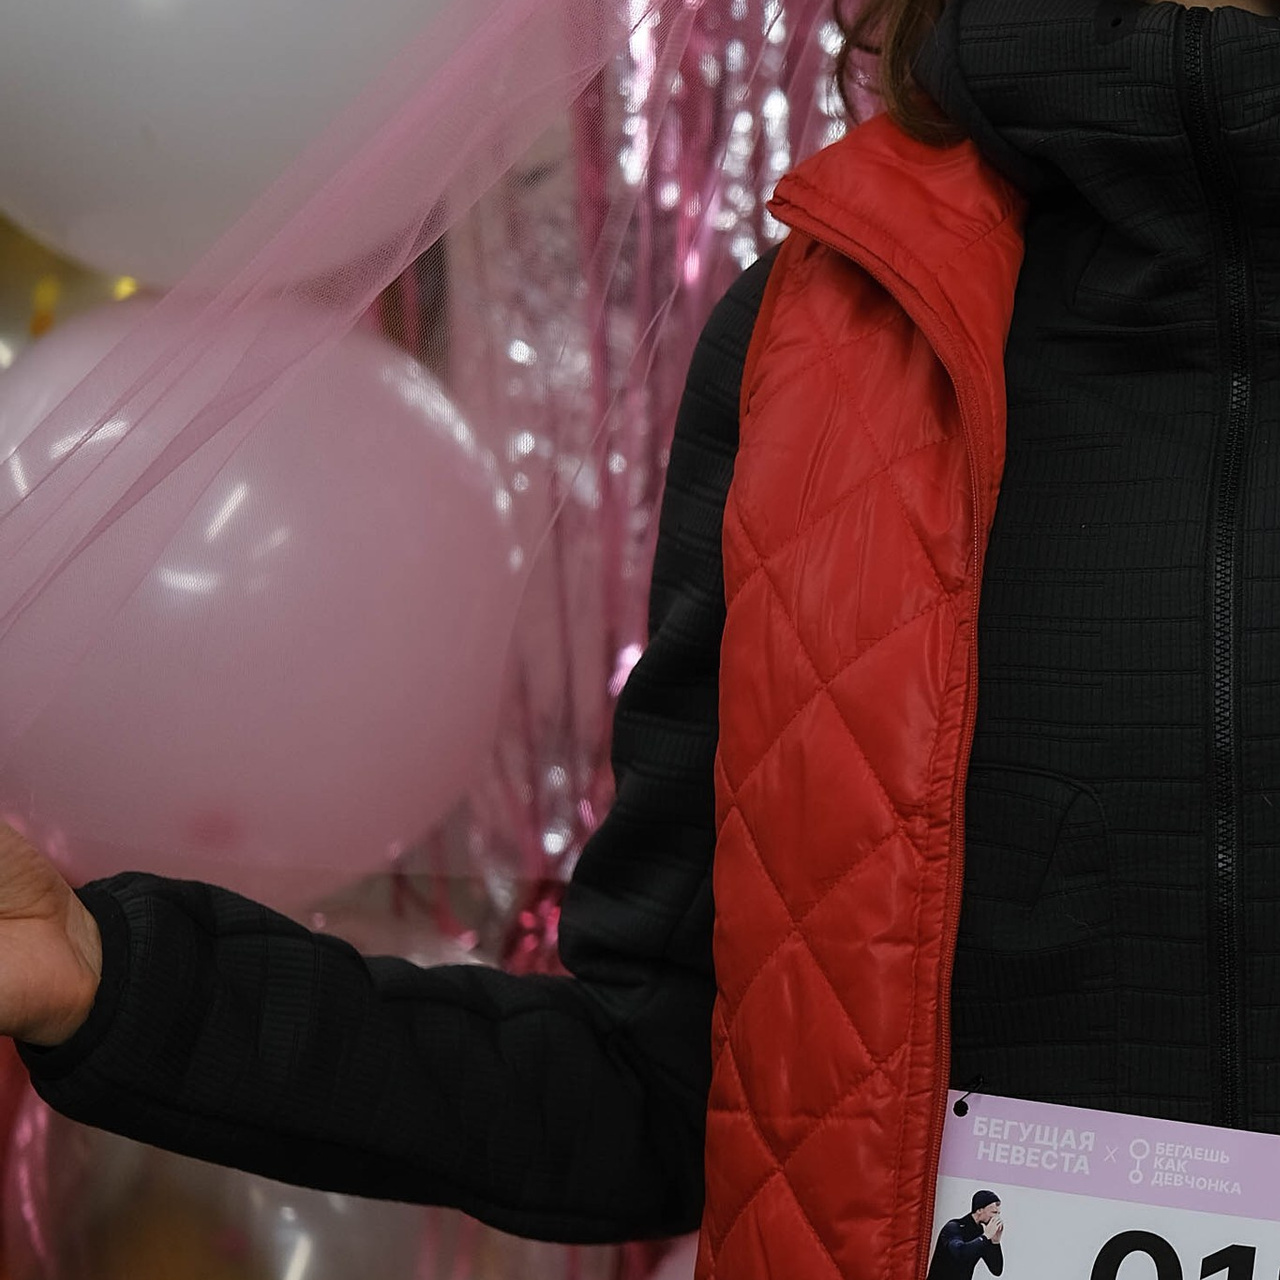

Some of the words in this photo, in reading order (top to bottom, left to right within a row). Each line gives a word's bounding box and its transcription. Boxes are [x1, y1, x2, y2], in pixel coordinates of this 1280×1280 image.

[973, 1116, 1096, 1152] БЕГУЩАЯ
[976, 1140, 1091, 1176] НЕВЕСТА
[1153, 1156, 1187, 1173] КАК
[1154, 1141, 1231, 1165] БЕГАЕШЬ
[1150, 1171, 1242, 1196] ДЕВЧОНКА
